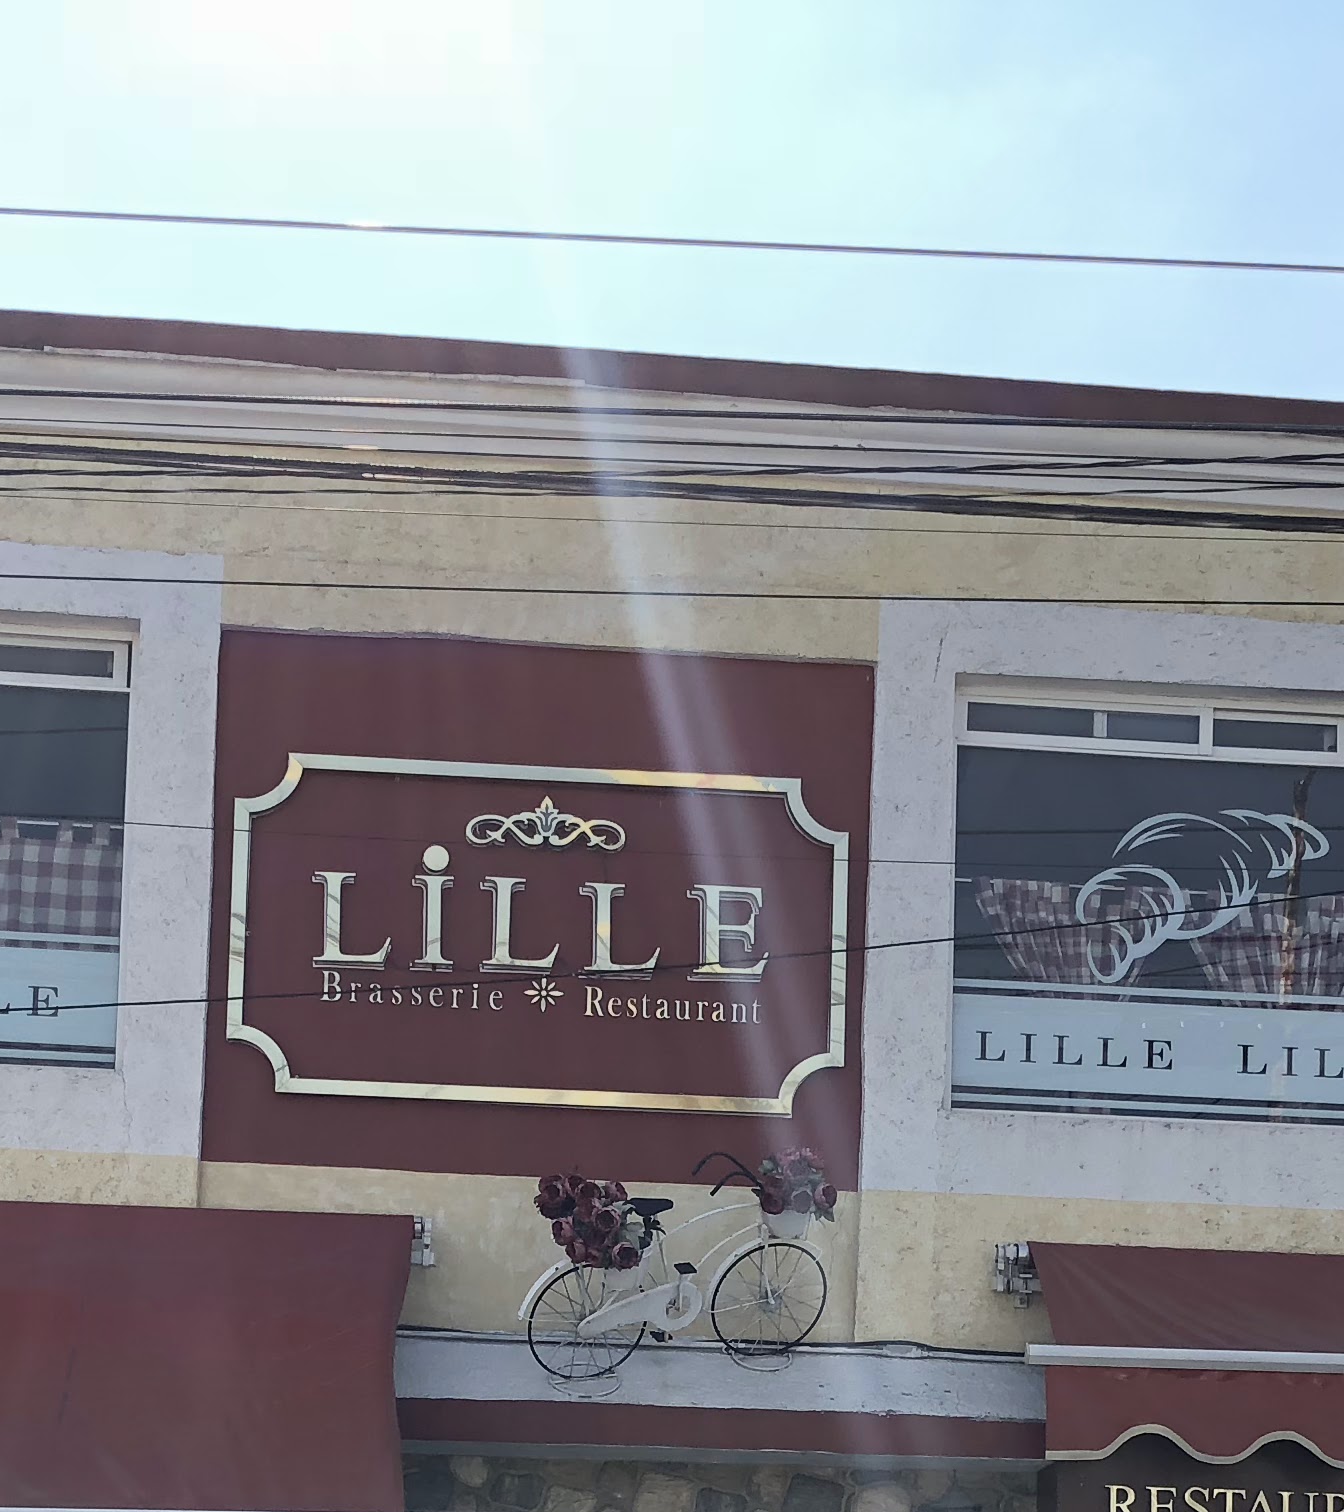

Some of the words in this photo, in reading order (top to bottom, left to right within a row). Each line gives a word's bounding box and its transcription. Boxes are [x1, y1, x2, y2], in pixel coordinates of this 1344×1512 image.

[319, 969, 504, 1011] Brasserie
[583, 985, 762, 1024] Restaurant
[974, 1030, 1174, 1070] LILLE
